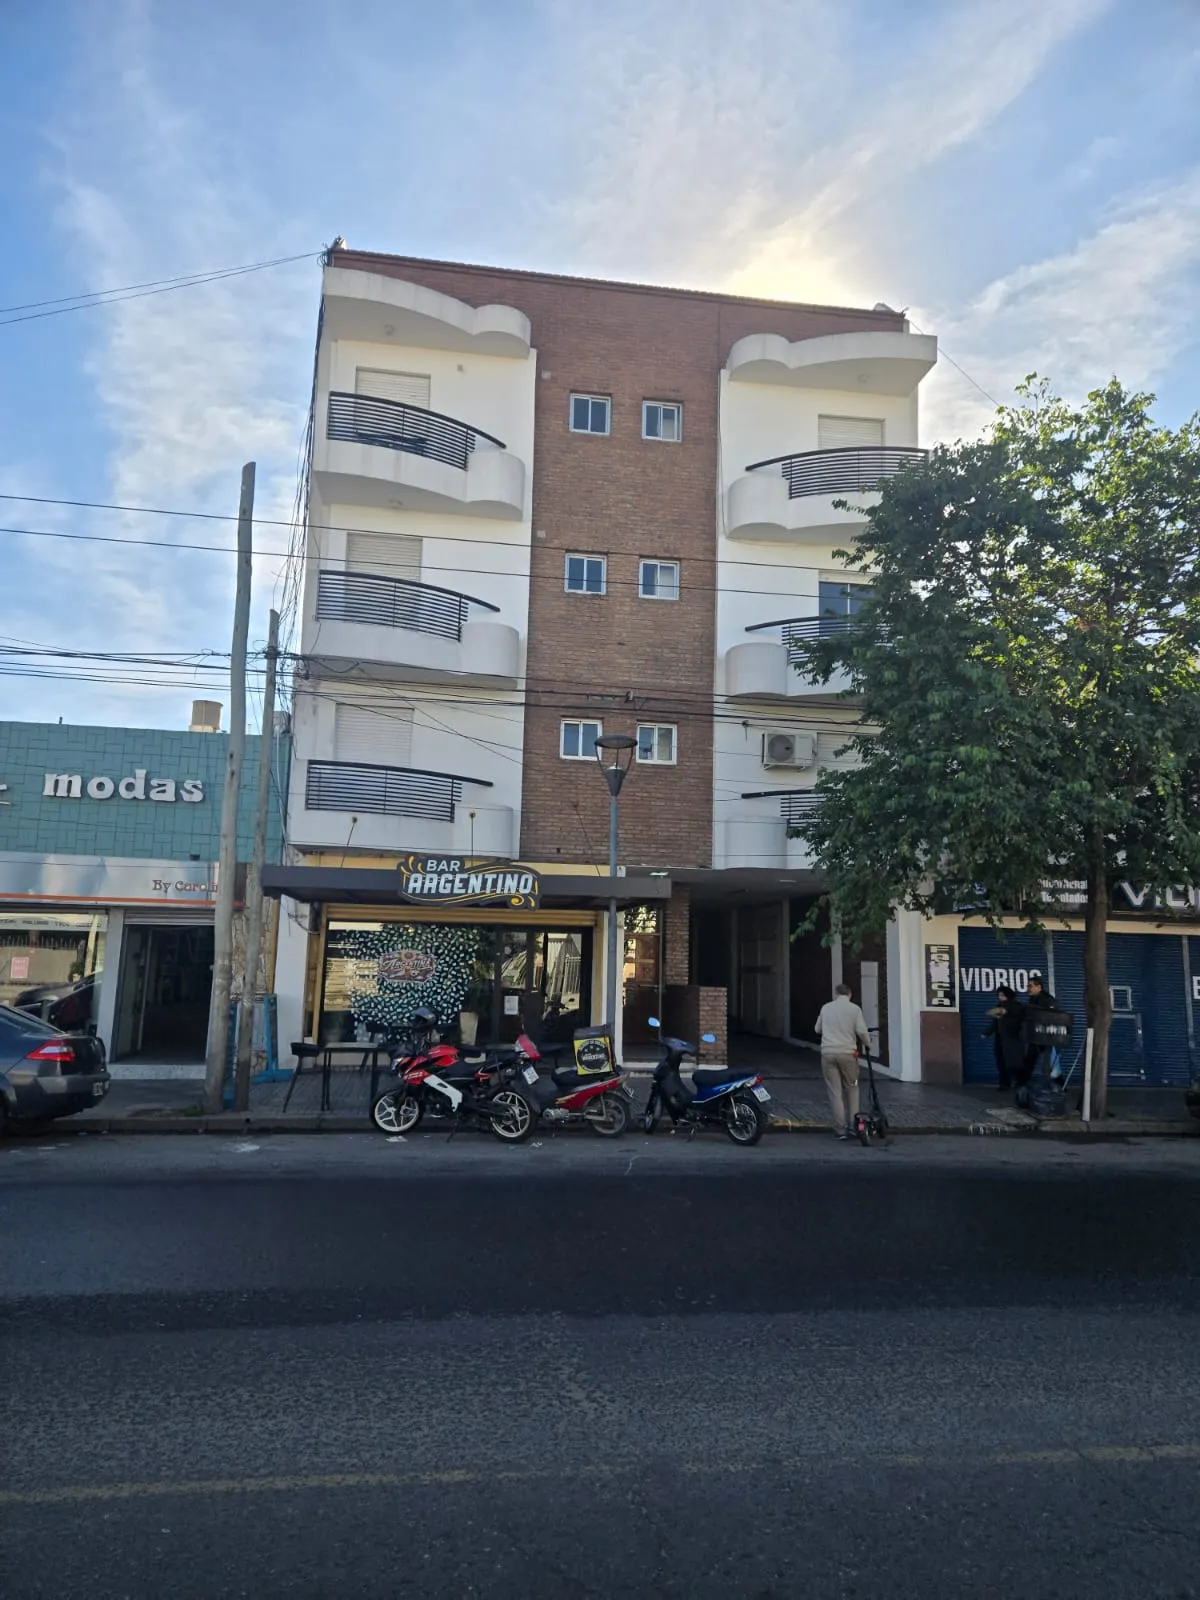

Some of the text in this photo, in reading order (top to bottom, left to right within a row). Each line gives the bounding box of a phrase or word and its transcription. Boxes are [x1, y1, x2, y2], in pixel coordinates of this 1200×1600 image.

[42, 769, 204, 802] modas
[426, 860, 461, 872] BAR
[152, 879, 171, 897] By
[407, 873, 533, 894] ARGENTINO
